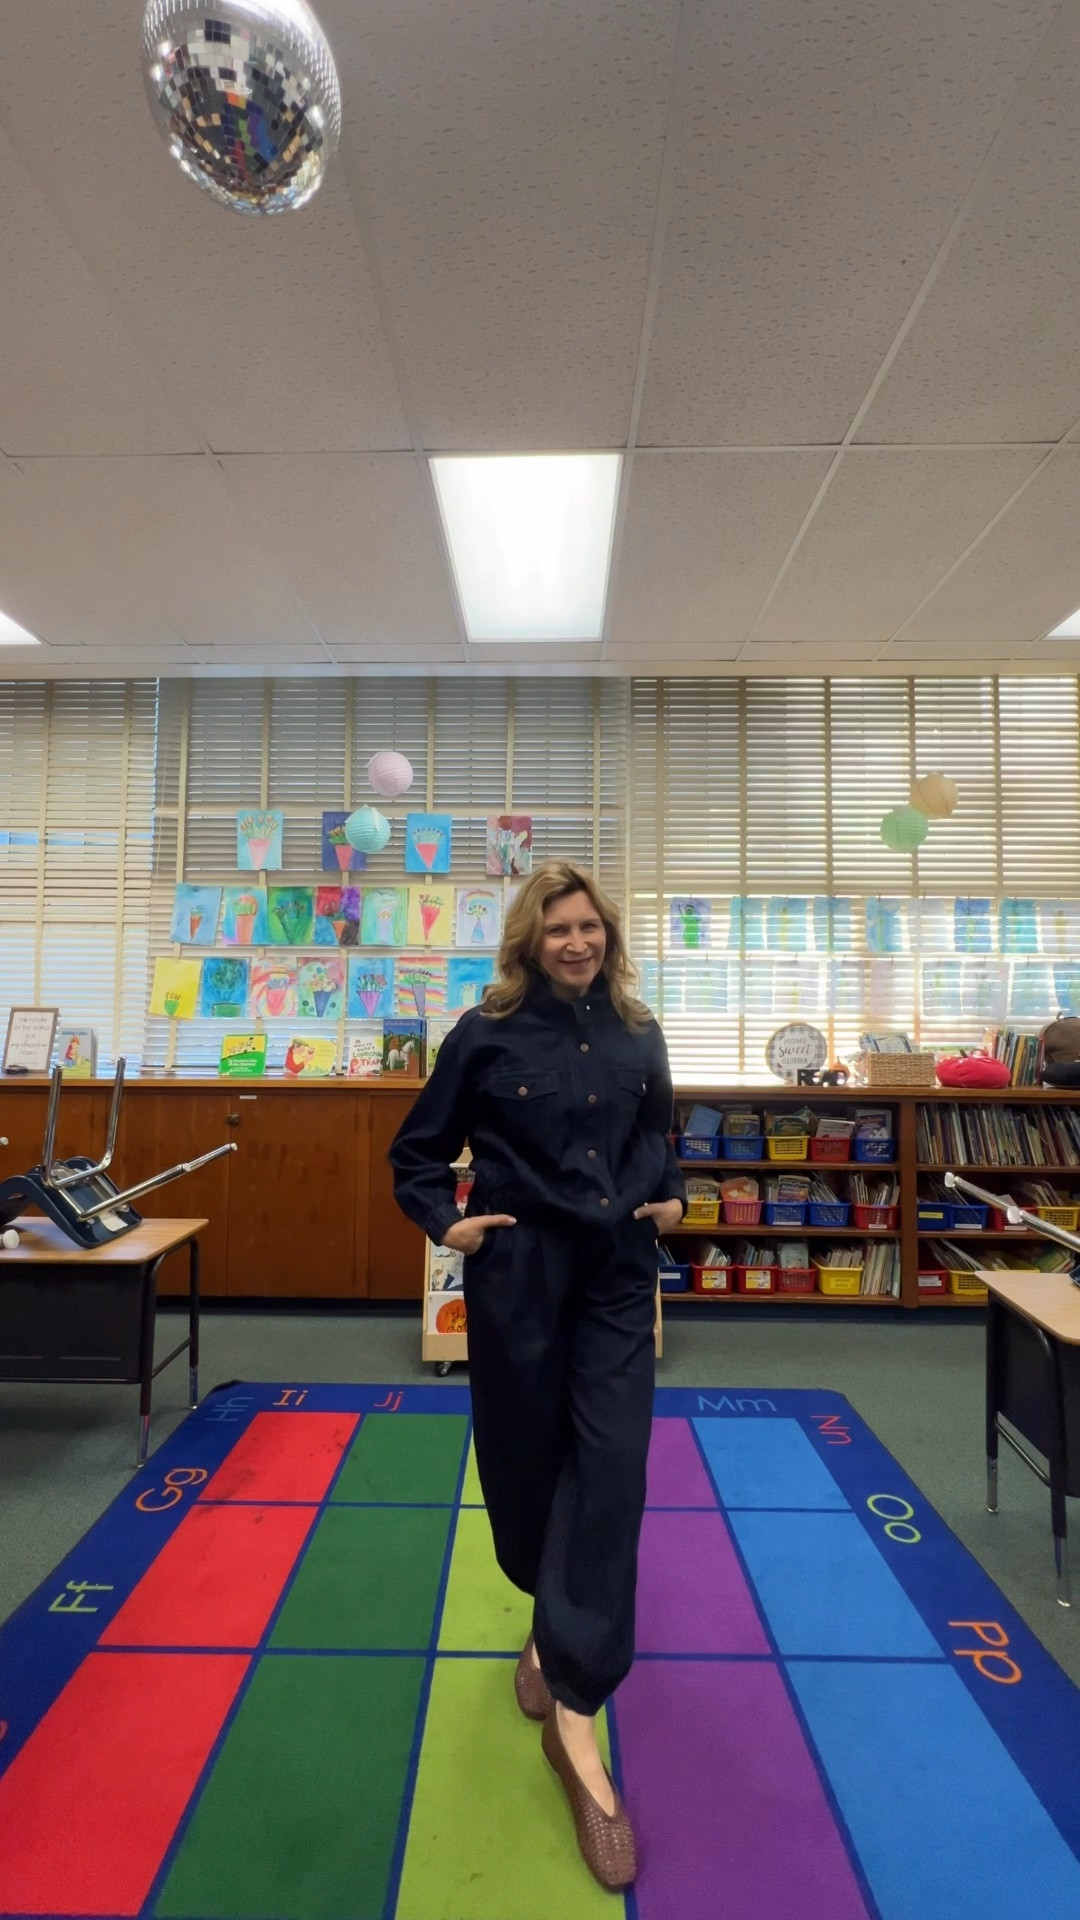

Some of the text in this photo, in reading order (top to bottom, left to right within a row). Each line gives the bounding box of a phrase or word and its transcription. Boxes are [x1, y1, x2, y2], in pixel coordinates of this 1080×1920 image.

[779, 1044, 811, 1057] sweet
[781, 1057, 808, 1065] CLASSROOM
[204, 1396, 255, 1422] Hh
[272, 1389, 308, 1407] Ii
[373, 1391, 404, 1411] Jj
[697, 1394, 777, 1413] Mm
[810, 1414, 852, 1445] Nn
[135, 1467, 208, 1512] Gg
[866, 1493, 921, 1543] Oo
[48, 1580, 114, 1613] Ff
[948, 1620, 1022, 1684] Pp
